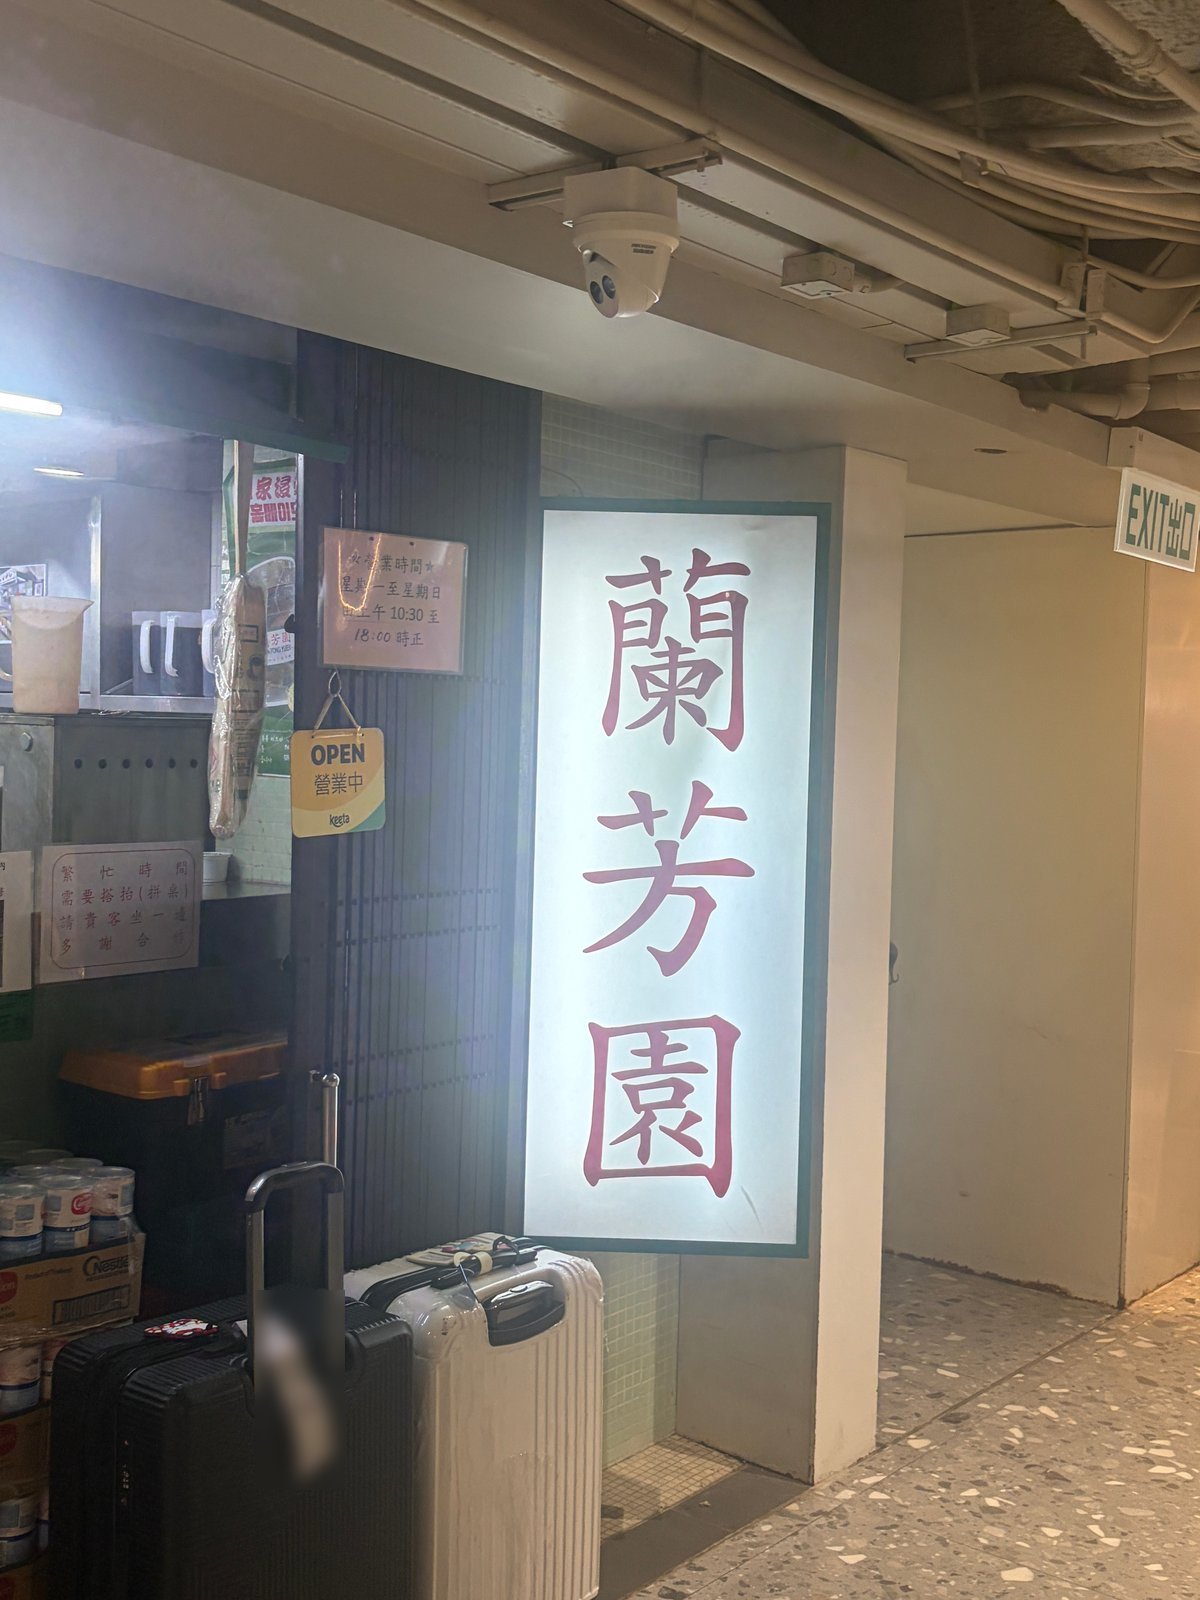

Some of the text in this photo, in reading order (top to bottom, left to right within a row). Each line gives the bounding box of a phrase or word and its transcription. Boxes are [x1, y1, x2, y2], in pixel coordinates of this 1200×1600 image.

[249, 475, 297, 501] 家浸
[1126, 484, 1196, 560] EXIT 出口
[391, 606, 424, 621] 10:30
[428, 610, 440, 624] 至
[354, 628, 424, 647] 18:00 時正
[311, 743, 365, 766] OPEN
[314, 771, 363, 796] 營業中
[329, 813, 350, 827] keeta
[61, 860, 188, 882] 繁忙時間
[583, 549, 755, 1198] 蘭芳園
